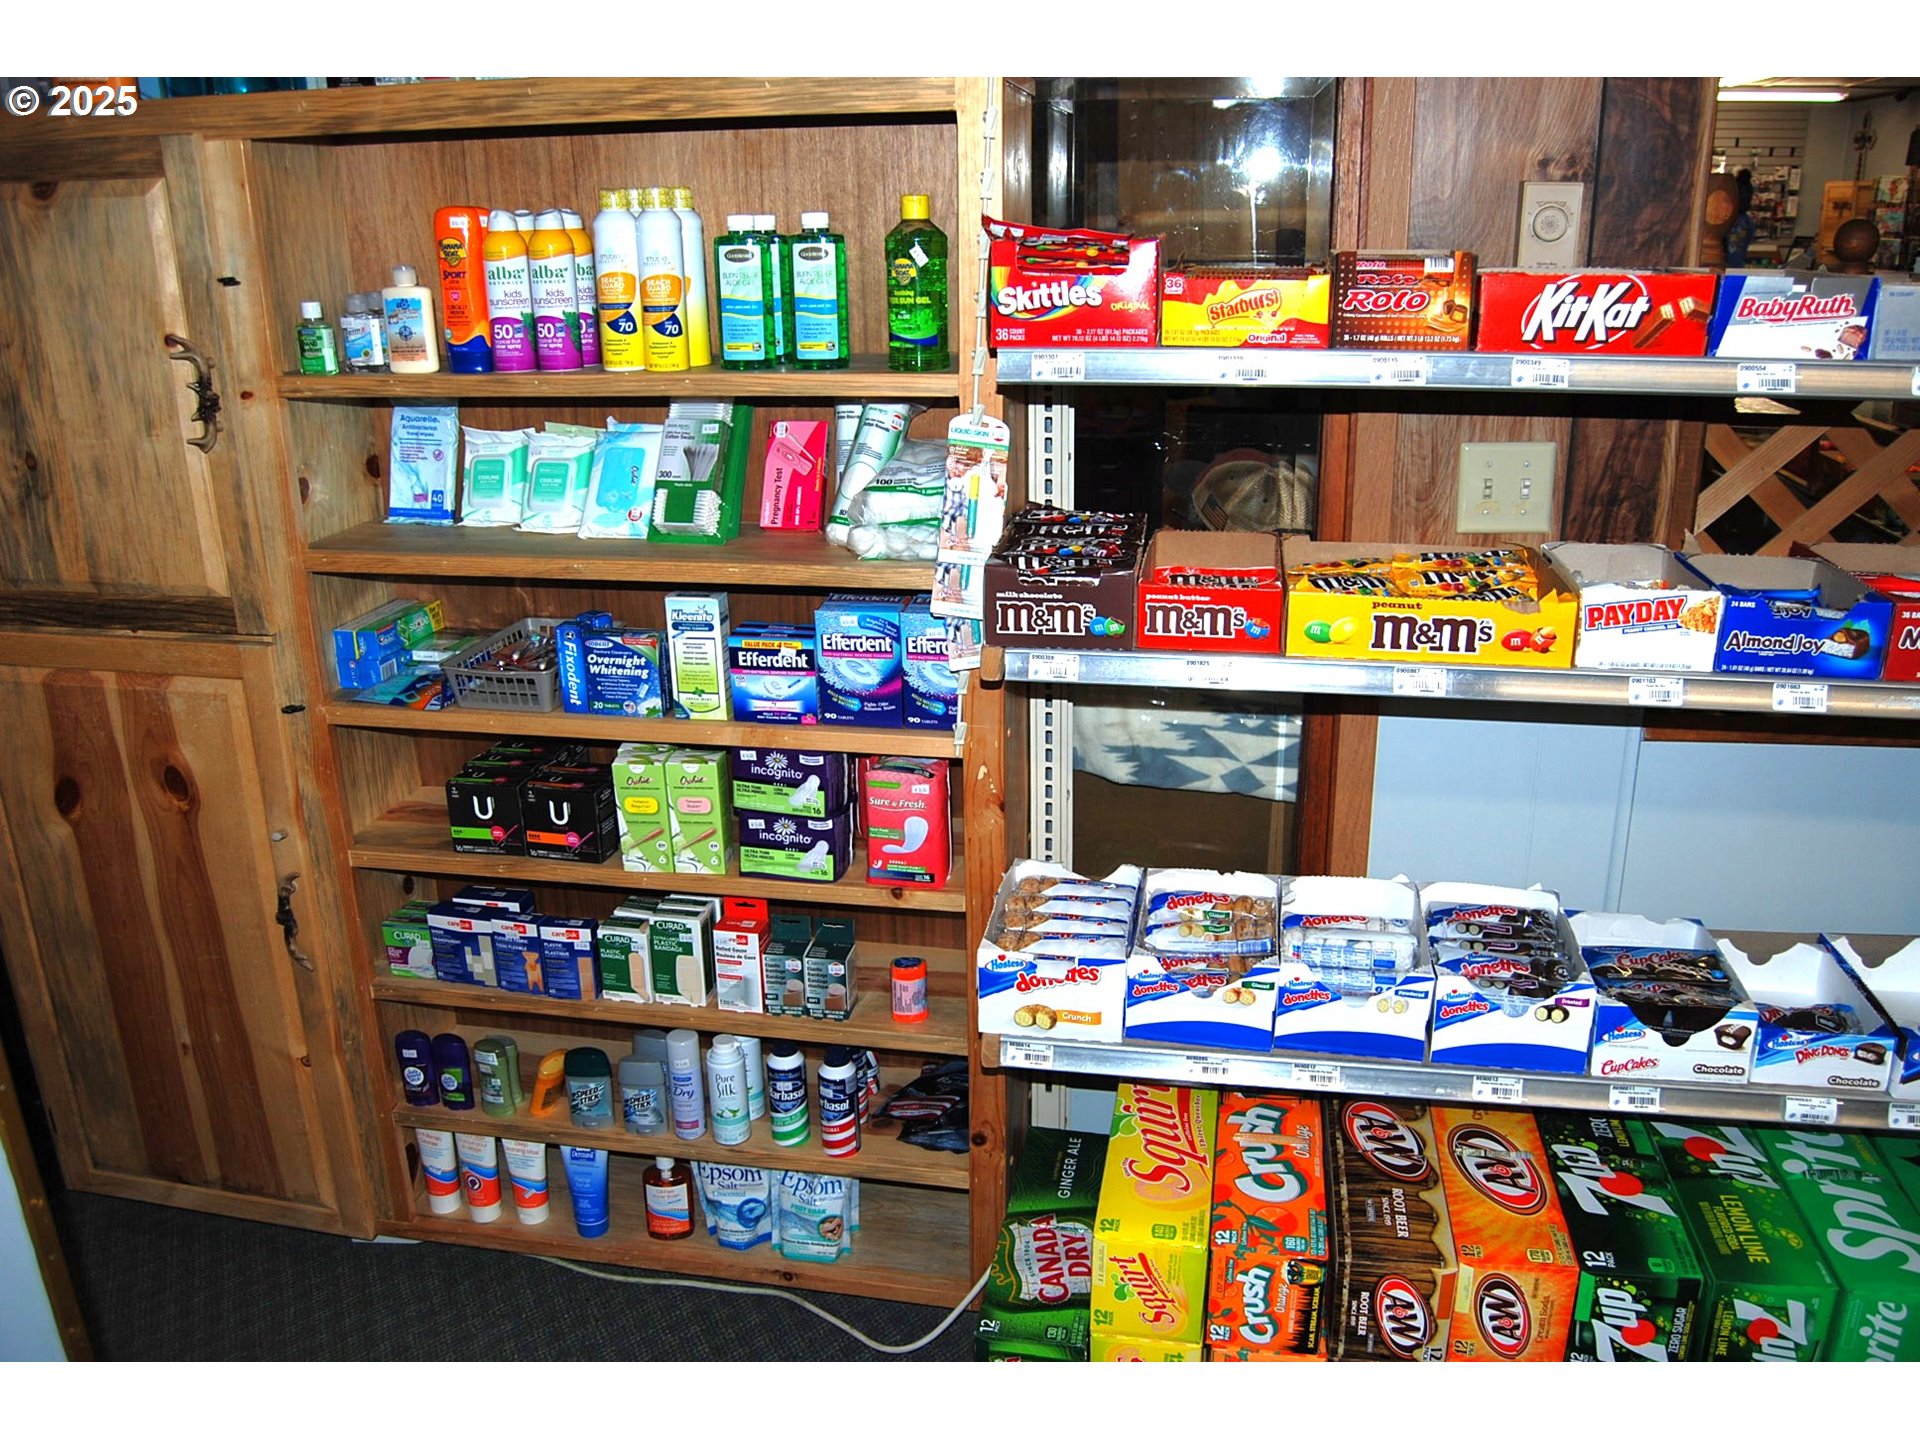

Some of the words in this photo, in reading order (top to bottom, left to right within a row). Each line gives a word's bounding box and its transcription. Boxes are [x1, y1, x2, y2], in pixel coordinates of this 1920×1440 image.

[443, 271, 467, 280] SPORT
[488, 264, 523, 280] alba
[532, 264, 566, 280] alba
[1356, 274, 1419, 285] Rolo
[1166, 279, 1182, 289] 36
[489, 296, 530, 307] sunscreen
[503, 289, 522, 299] kids
[533, 296, 573, 305] sunscreen
[545, 288, 565, 299] kids
[998, 280, 1102, 316] Skittles
[1343, 290, 1429, 311] Rolo
[1209, 291, 1280, 321] Starburst
[494, 324, 513, 339] 50
[537, 323, 555, 339] 50
[618, 322, 634, 332] 70
[663, 324, 679, 335] 70
[995, 328, 1009, 341] 36
[1247, 334, 1287, 344] Original
[972, 428, 990, 438] SKIN
[539, 477, 563, 485] COOLING
[658, 470, 673, 479] 300
[774, 467, 784, 488] Test
[875, 478, 893, 486] 100
[432, 493, 443, 503] 40
[771, 489, 781, 525] Pregnancy
[1018, 592, 1063, 600] chocolate
[1145, 593, 1178, 601] peanut
[1372, 601, 1423, 610] peanut
[1587, 597, 1686, 630] PAYDAY
[671, 609, 714, 622] Kleenite
[997, 601, 1096, 636] m&m's
[1145, 602, 1247, 639] m&m's
[1370, 612, 1495, 655] m&m's
[744, 640, 760, 649] VALUE
[760, 641, 775, 649] PACK
[822, 633, 893, 652] Efferdent
[587, 654, 647, 668] Overnight
[738, 651, 810, 669] Efferdent
[564, 640, 582, 706] Fixodent
[589, 665, 650, 679] Whitening
[593, 701, 604, 709] 20
[824, 712, 837, 720] 90
[751, 763, 804, 781] incognito
[473, 795, 494, 821] U
[869, 796, 890, 806] Sure
[549, 799, 571, 826] U
[812, 807, 822, 815] 16
[759, 829, 812, 847] incognito
[1167, 891, 1231, 911] donettes
[1445, 905, 1519, 925] donettes
[655, 921, 684, 930] CURAD
[393, 931, 421, 942] CURAD
[604, 935, 630, 944] CURAD
[653, 945, 683, 953] BANDAGE
[990, 958, 1026, 970] Hostess
[1461, 959, 1532, 980] donettes
[1132, 981, 1179, 998] donettes
[1283, 989, 1331, 1006] donettes
[1397, 990, 1425, 999] Powdered
[1440, 1000, 1490, 1018] donettes
[1561, 998, 1583, 1006] Frosted
[1062, 1011, 1092, 1023] Crunch
[1608, 1030, 1643, 1042] Hostess
[1773, 1038, 1806, 1050] Hostess
[1820, 1045, 1850, 1061] DONGS
[1693, 1065, 1745, 1076] Chocolate
[715, 1073, 735, 1085] Pure
[1828, 1076, 1880, 1088] Chocolate
[575, 1086, 599, 1099] SPEED
[578, 1093, 600, 1105] STICK
[673, 1087, 695, 1100] Dry
[716, 1083, 737, 1099] Silk
[629, 1094, 650, 1106] SPEED
[632, 1101, 652, 1112] STICK
[1067, 1136, 1082, 1158] ALE
[1351, 1113, 1425, 1165] A&W
[699, 1165, 763, 1183] Epsom
[1057, 1157, 1079, 1199] GINGER
[717, 1181, 738, 1190] Salt
[780, 1171, 843, 1196] Epsom
[712, 1190, 747, 1198] Unscented
[798, 1195, 818, 1207] Salt
[1391, 1188, 1406, 1214] ROOT
[1100, 1218, 1114, 1233] 12
[1394, 1215, 1410, 1239] BEER
[1719, 1194, 1754, 1236] LEMON
[1738, 1234, 1771, 1264] LIME
[1214, 1230, 1230, 1245] 12
[1032, 1213, 1071, 1303] CANADA
[1062, 1233, 1093, 1278] DRY
[1461, 1244, 1476, 1258] 12
[1583, 1251, 1606, 1268] 12
[1109, 1253, 1176, 1325] Squirt
[1236, 1265, 1276, 1345] Crush
[1275, 1282, 1290, 1313] Orange
[1360, 1291, 1370, 1315] ROOT
[1538, 1294, 1550, 1320] Soda
[1094, 1308, 1108, 1326] 12
[1382, 1291, 1425, 1342] A&W
[1482, 1290, 1522, 1341] A&W
[1673, 1307, 1687, 1331] SUGAR
[1719, 1310, 1730, 1333] LEMON
[980, 1319, 996, 1333] 12
[1209, 1324, 1225, 1341] 12
[1356, 1315, 1368, 1337] BEER
[1535, 1320, 1547, 1345] Cream
[1453, 1339, 1469, 1356] 12
[1668, 1331, 1681, 1354] ZERO
[1715, 1333, 1728, 1356] LIME
